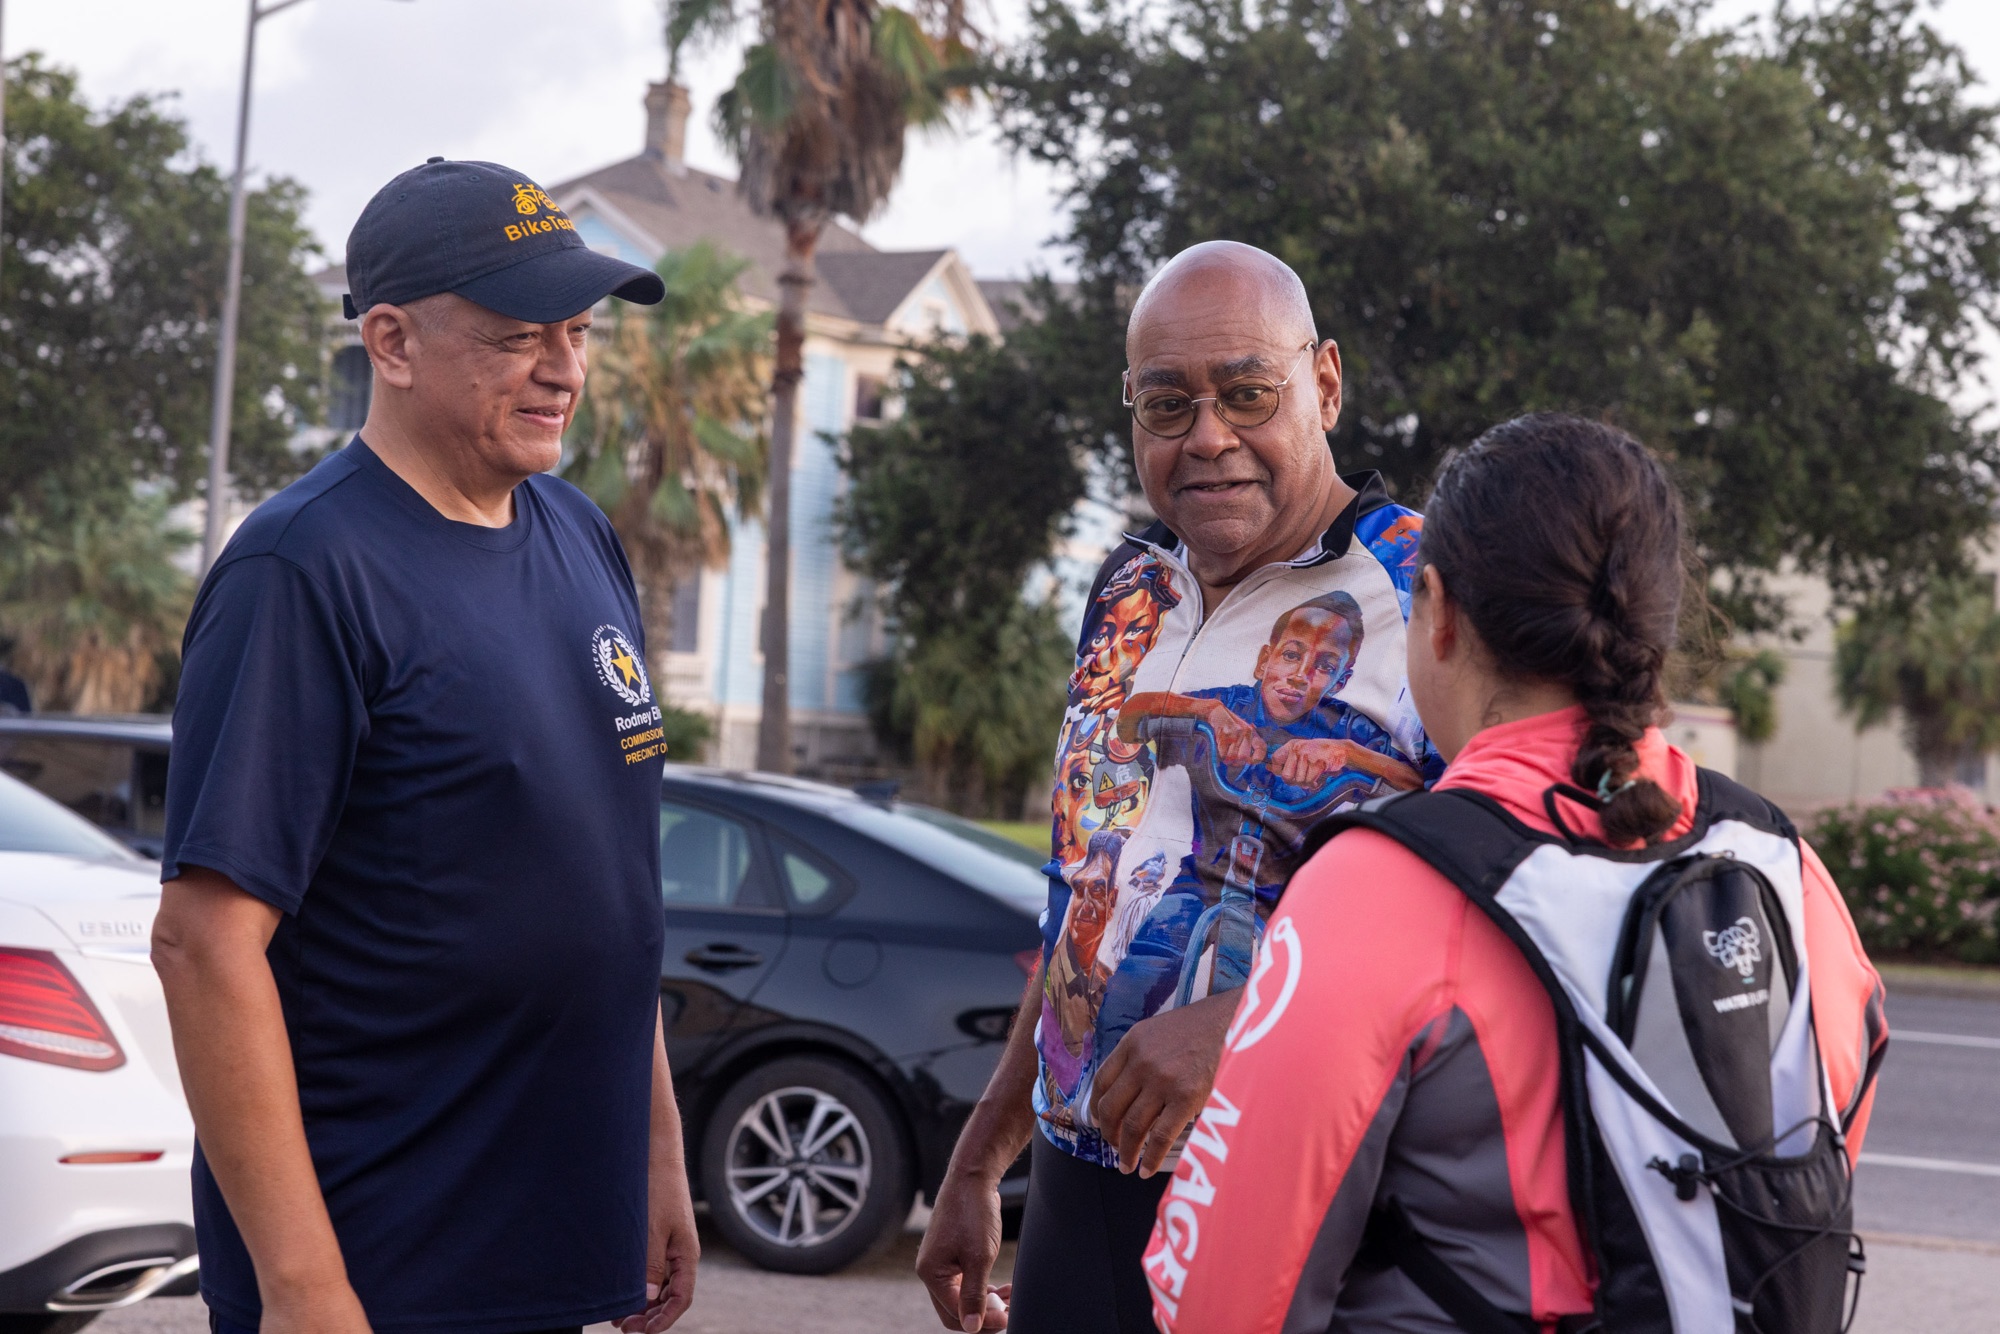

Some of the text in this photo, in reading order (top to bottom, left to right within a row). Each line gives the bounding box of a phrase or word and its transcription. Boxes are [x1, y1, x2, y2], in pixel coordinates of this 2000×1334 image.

[504, 215, 577, 242] BikeTex
[591, 644, 599, 655] OF
[593, 657, 609, 687] STATE
[614, 710, 652, 732] Rodney
[620, 726, 665, 750] COMMISSION
[625, 744, 660, 766] PRECINCT
